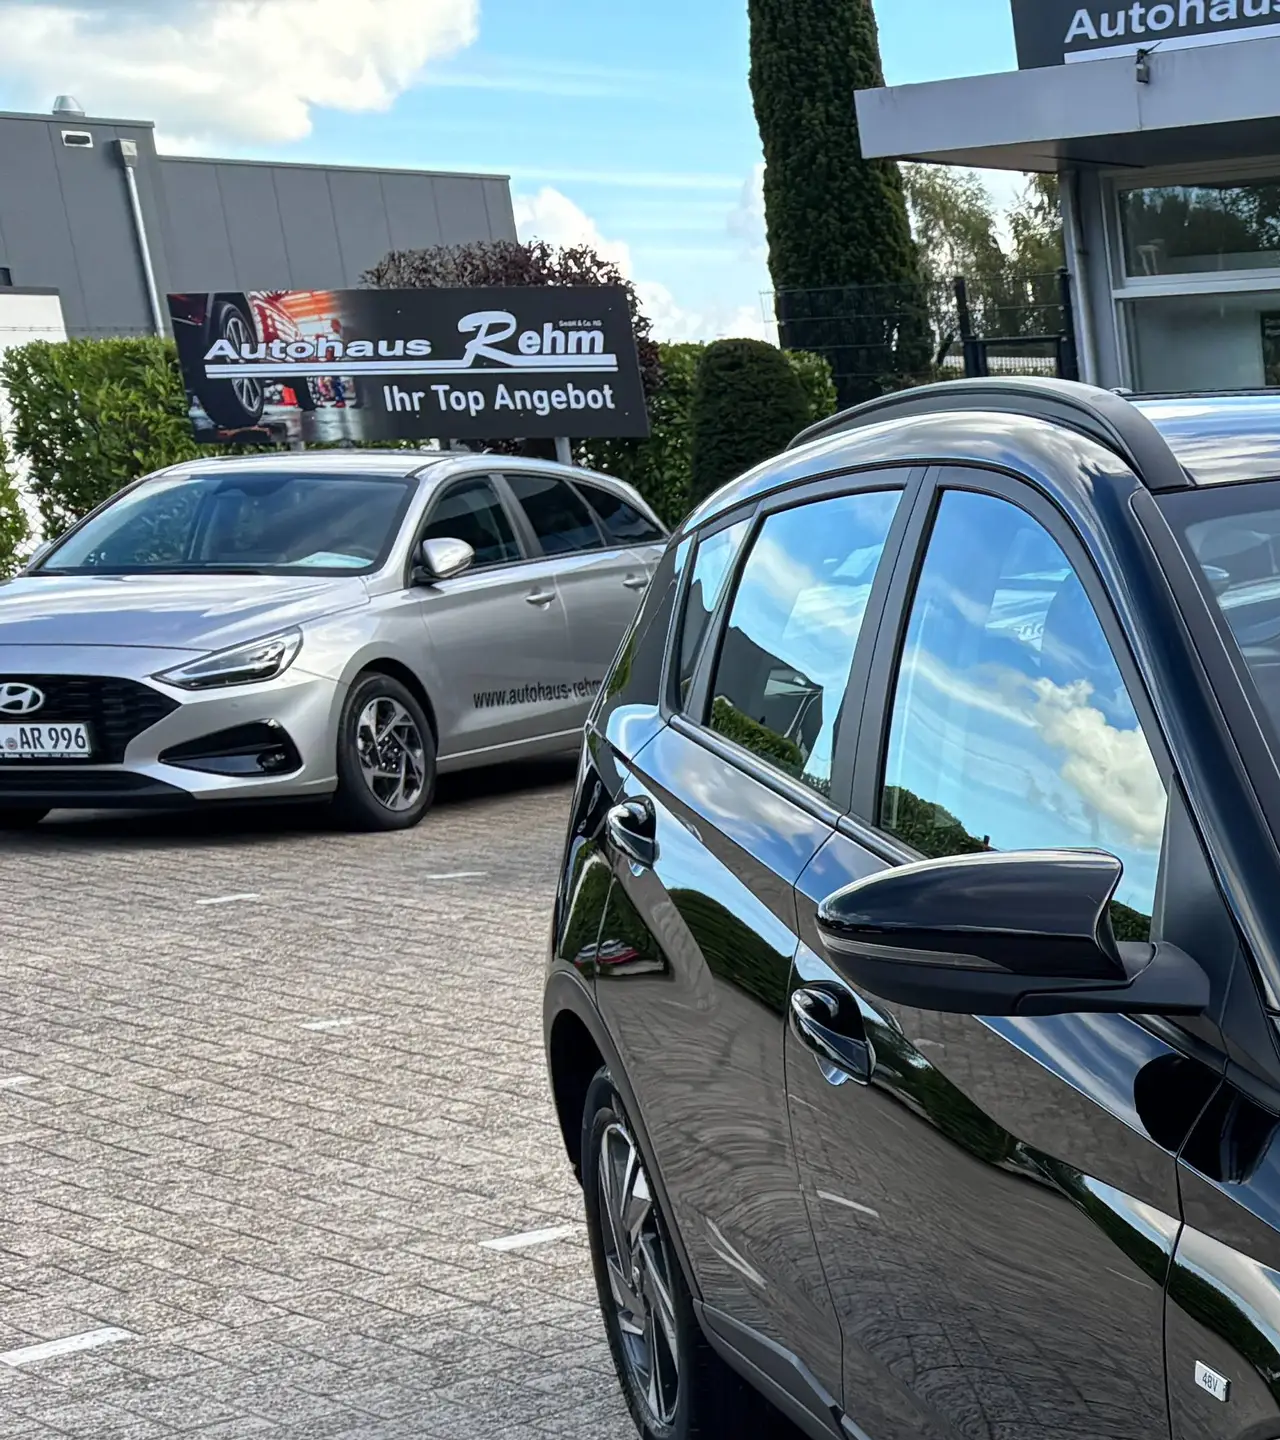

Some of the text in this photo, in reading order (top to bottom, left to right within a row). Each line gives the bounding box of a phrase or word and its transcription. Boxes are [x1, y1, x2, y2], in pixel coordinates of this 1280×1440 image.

[203, 310, 605, 364] Autohaus Rehm
[384, 383, 616, 417] Ihr Top Angebot
[20, 727, 87, 750] AR 996
[1202, 1372, 1219, 1392] 48V
